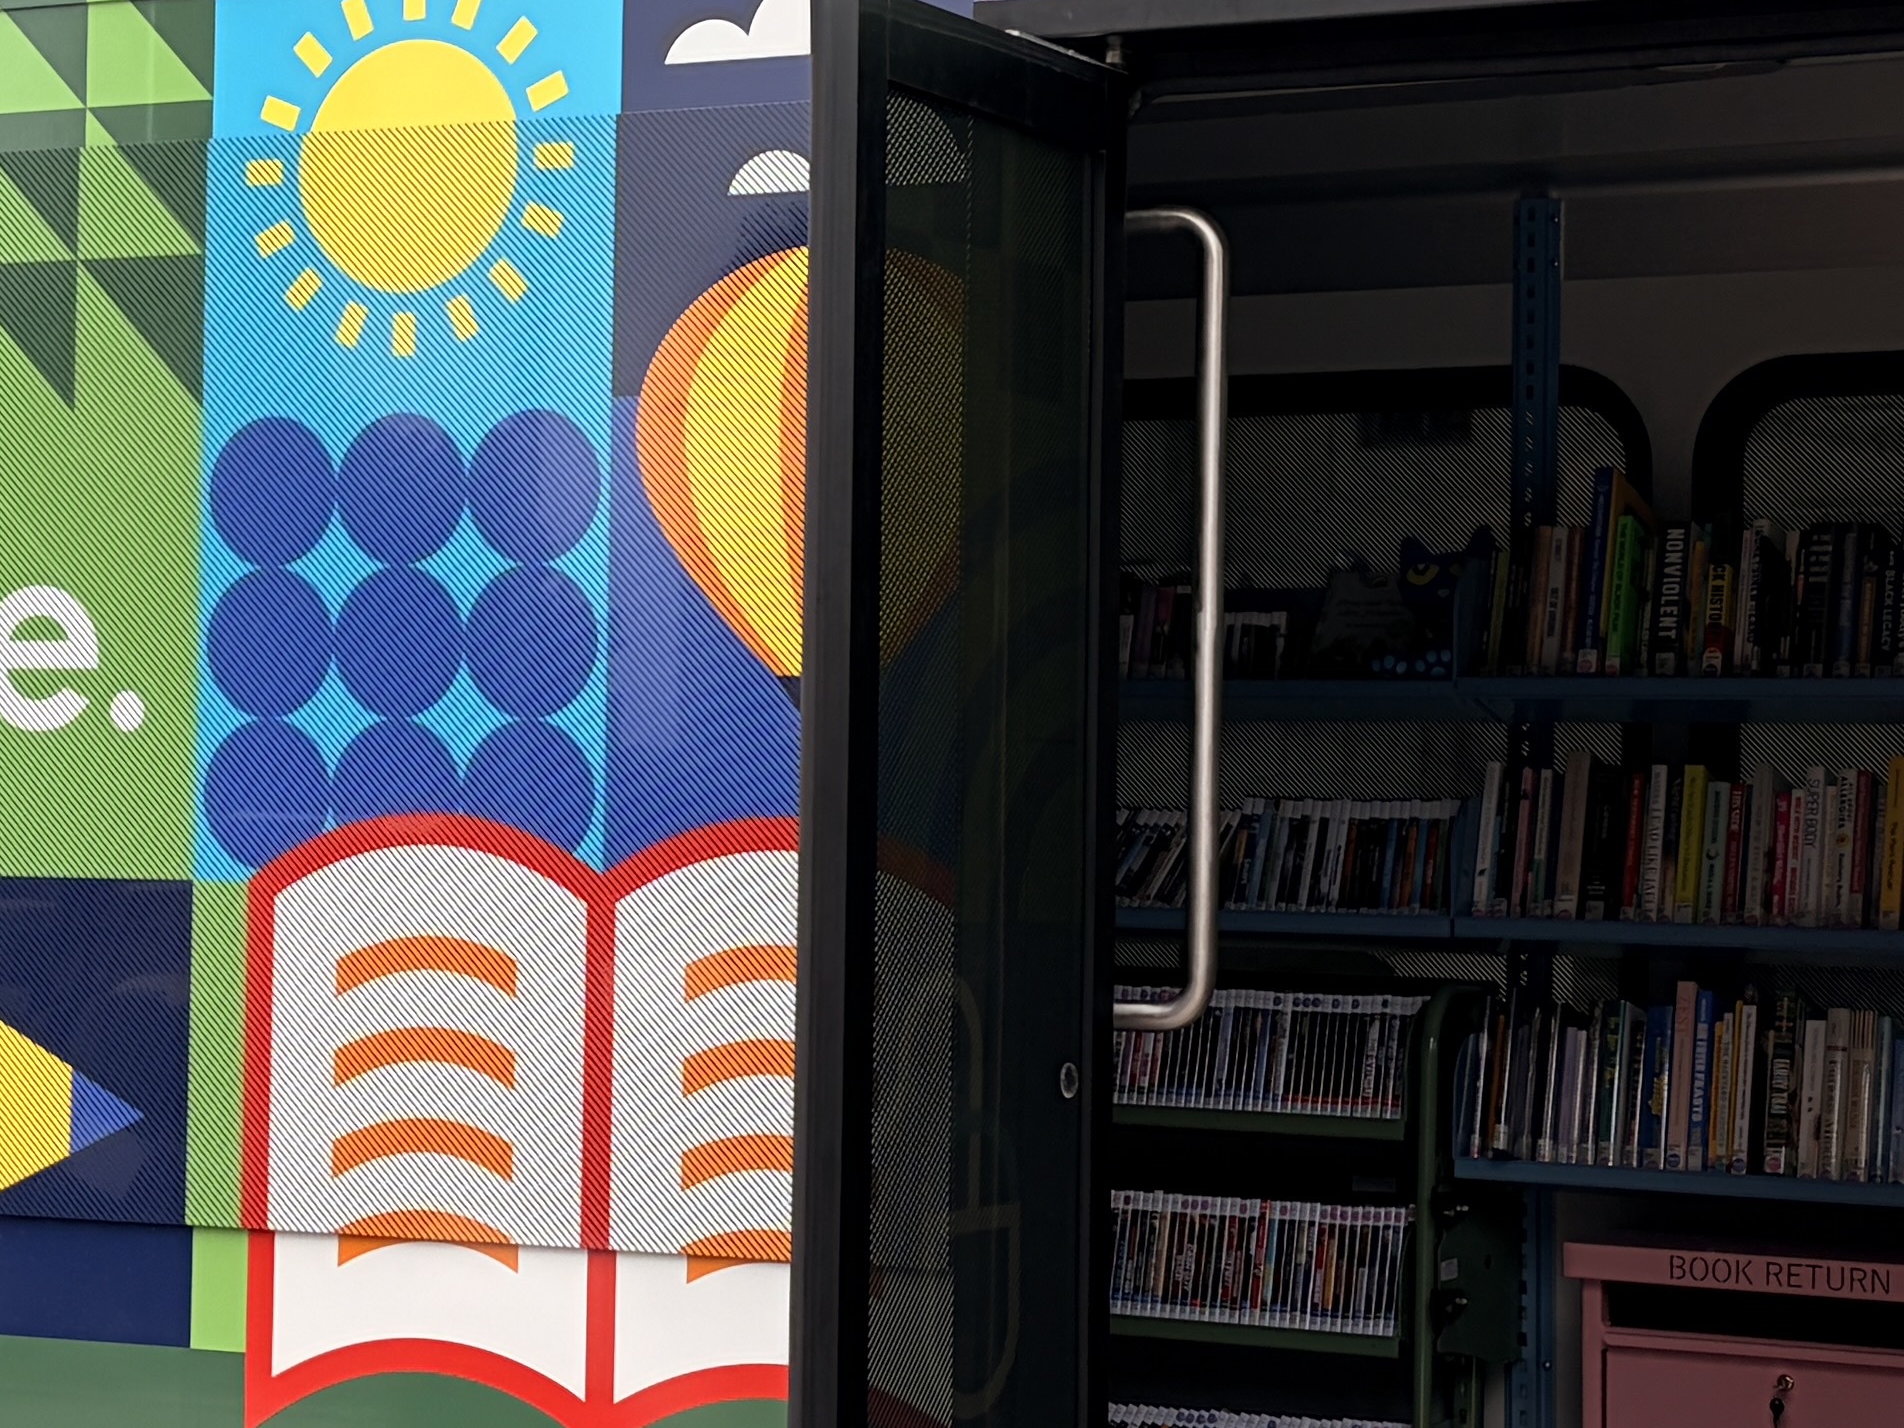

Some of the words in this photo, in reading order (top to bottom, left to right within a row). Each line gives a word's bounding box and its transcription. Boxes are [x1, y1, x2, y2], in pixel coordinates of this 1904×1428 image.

[1657, 528, 1686, 640] NONVIOLENT
[1668, 1255, 1753, 1287] BOOK
[1765, 1261, 1891, 1295] RETURN
